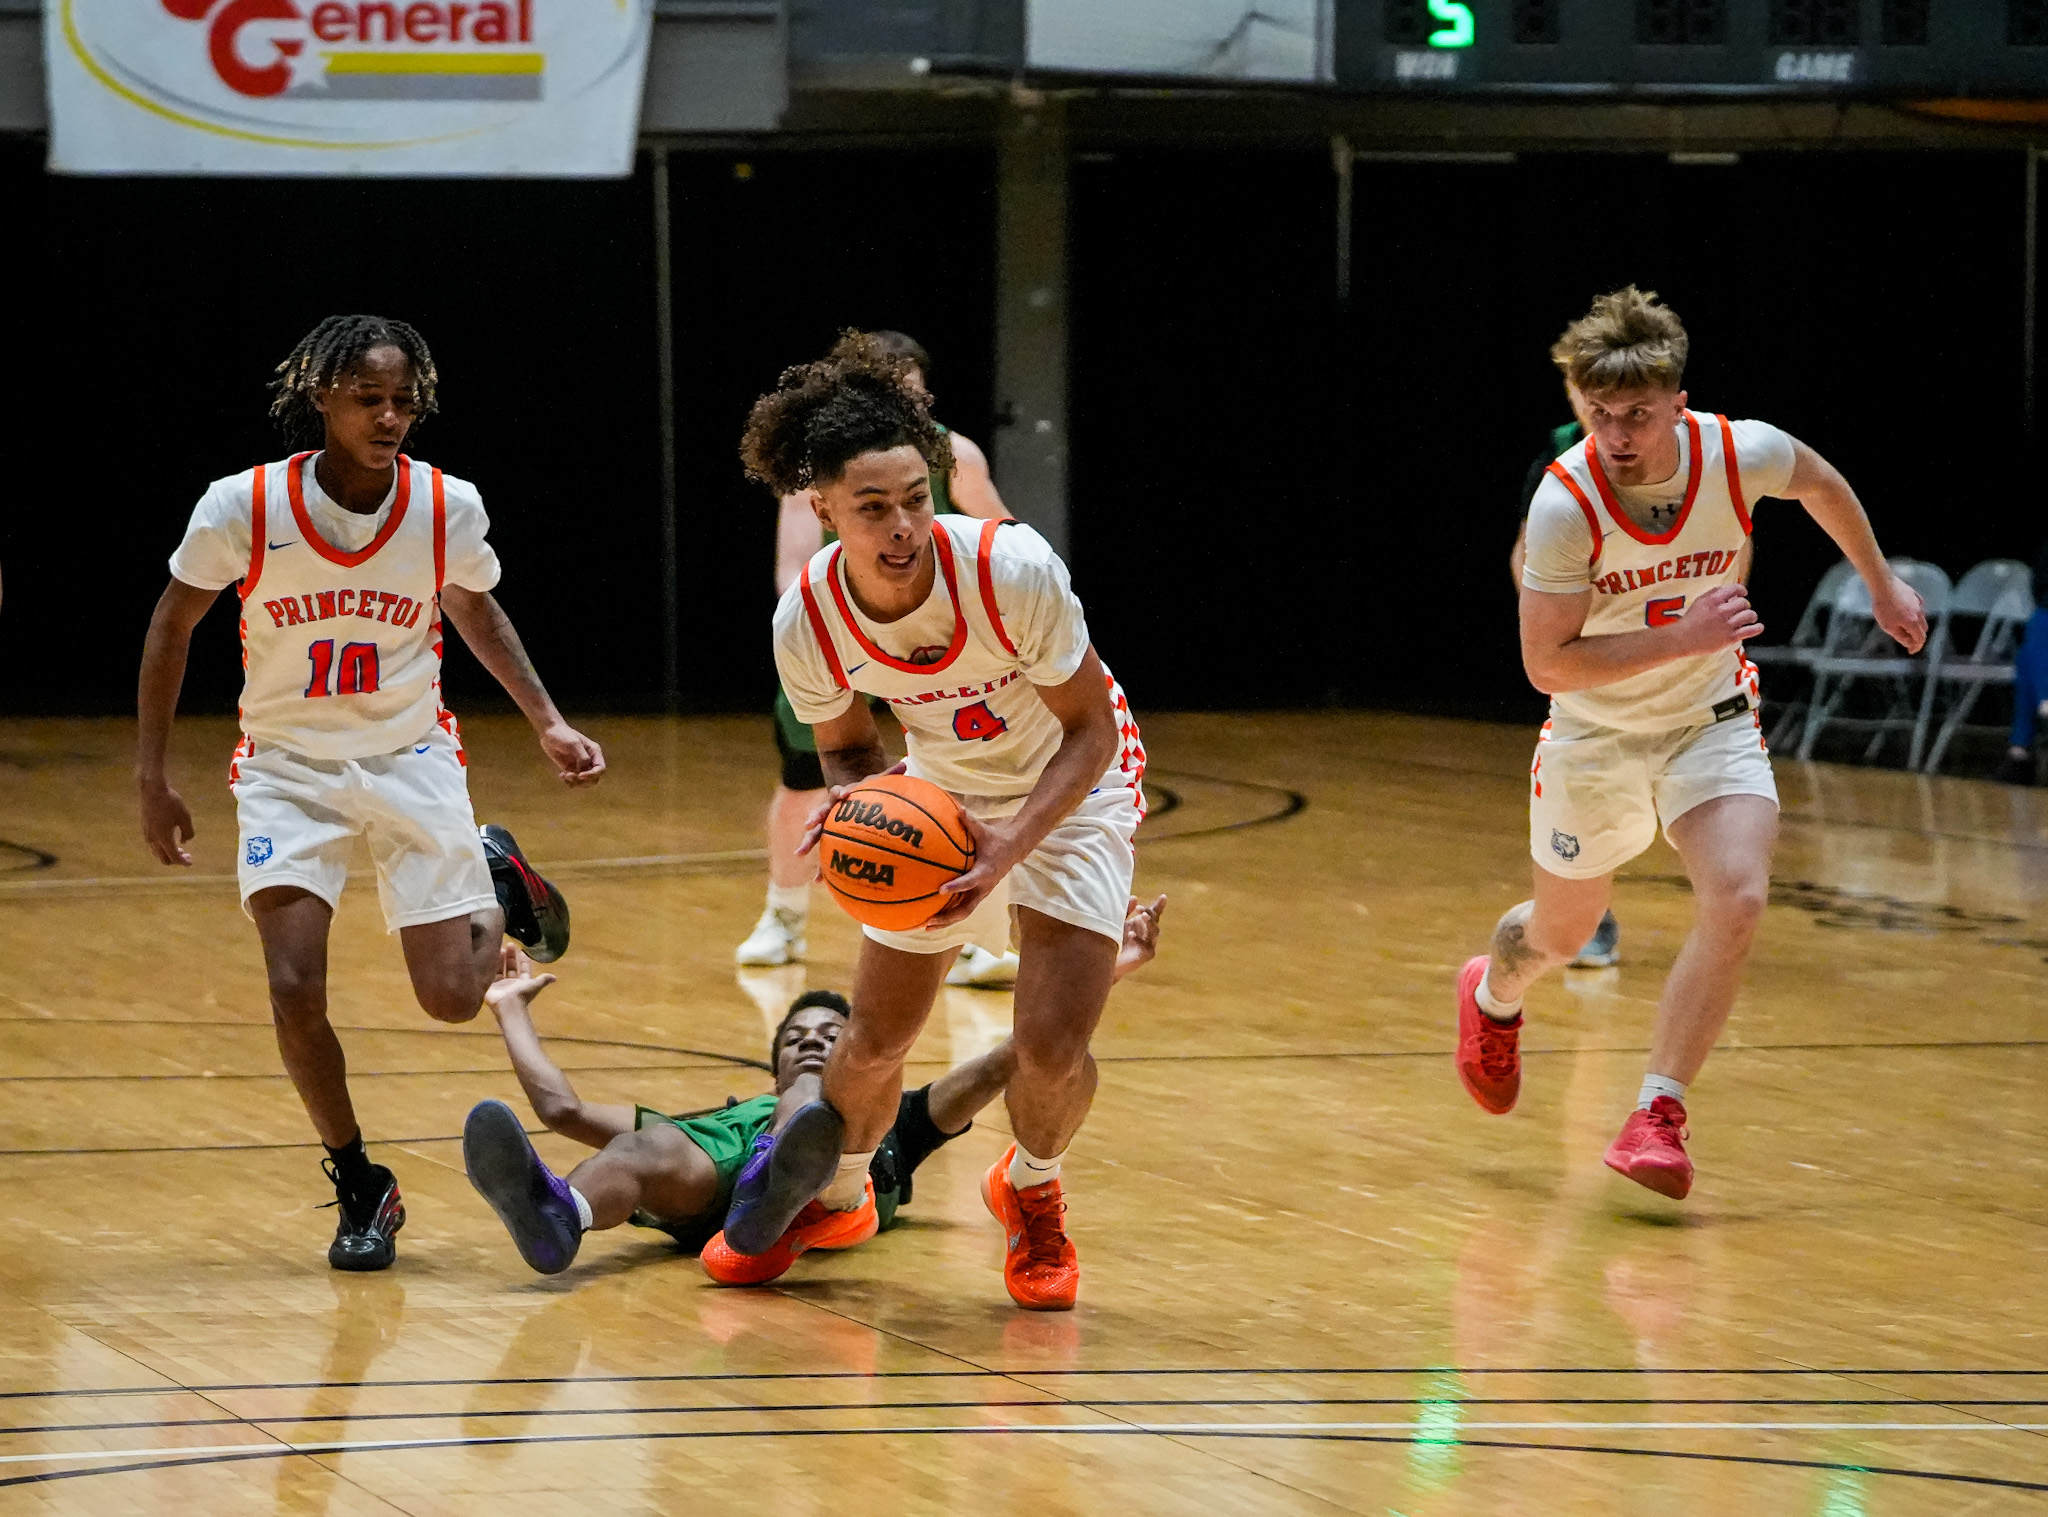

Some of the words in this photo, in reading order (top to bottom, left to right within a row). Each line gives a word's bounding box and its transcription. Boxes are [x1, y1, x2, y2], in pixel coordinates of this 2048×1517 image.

[1427, 0, 1475, 48] 5
[304, 638, 381, 698] 10
[952, 699, 1009, 742] 4
[835, 799, 924, 848] Wilson
[830, 849, 894, 886] NCAA
